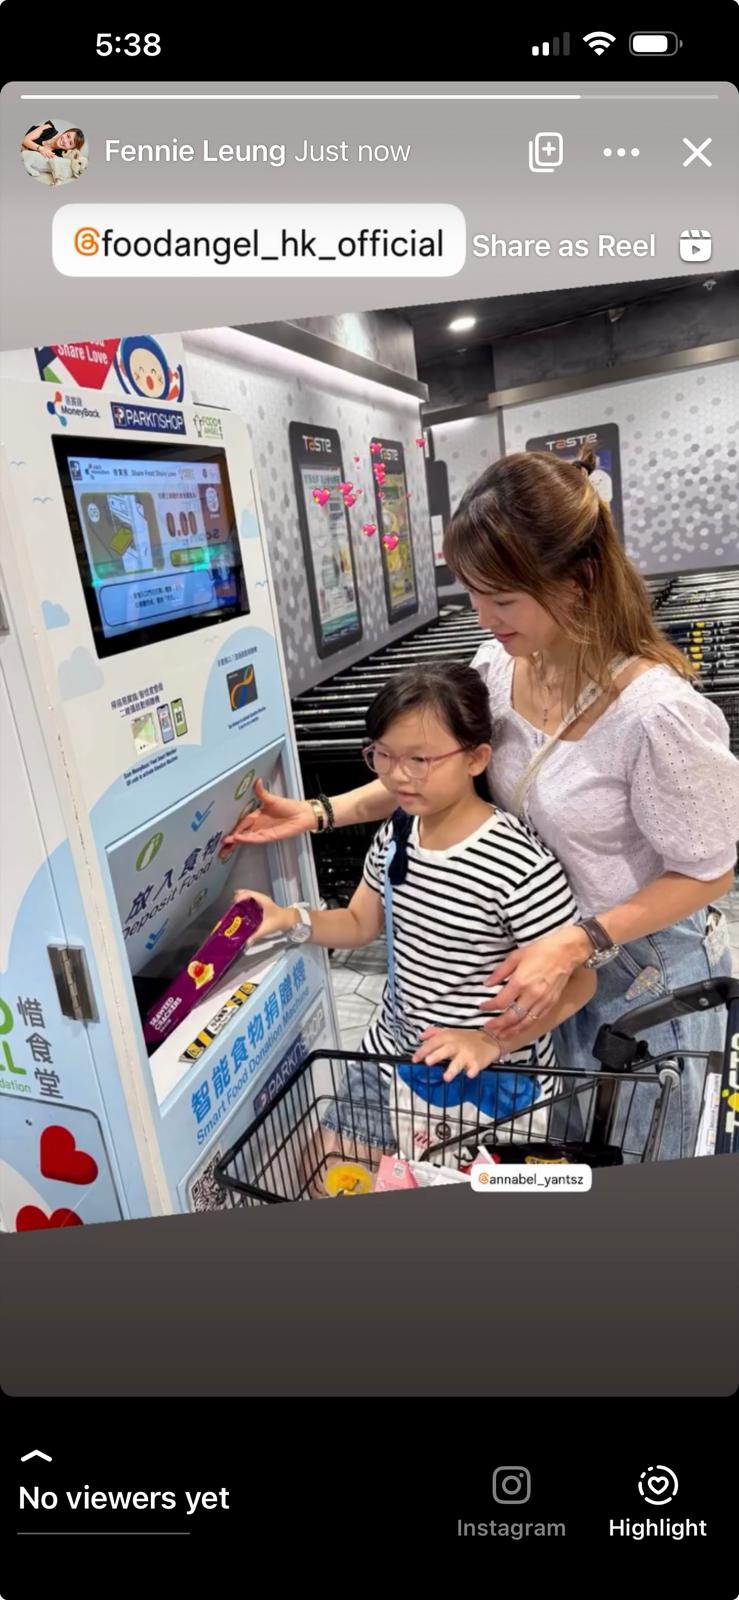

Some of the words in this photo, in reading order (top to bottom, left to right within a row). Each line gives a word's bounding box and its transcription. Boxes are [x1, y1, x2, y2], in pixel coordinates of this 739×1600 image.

[57, 344, 85, 361] Share
[85, 345, 108, 365] Love
[61, 405, 101, 418] MoneyBack
[166, 511, 198, 537] 0.00
[124, 830, 223, 925] 放入食物
[179, 857, 214, 896] Food
[149, 996, 175, 1026] SEAWEED
[155, 997, 183, 1031] CRACKERS
[16, 995, 64, 1100] 惜食堂
[191, 956, 306, 1125] 智能食物捐贈機
[197, 1100, 226, 1145] Smart
[226, 1068, 249, 1105] Food
[248, 1023, 283, 1073] Donation
